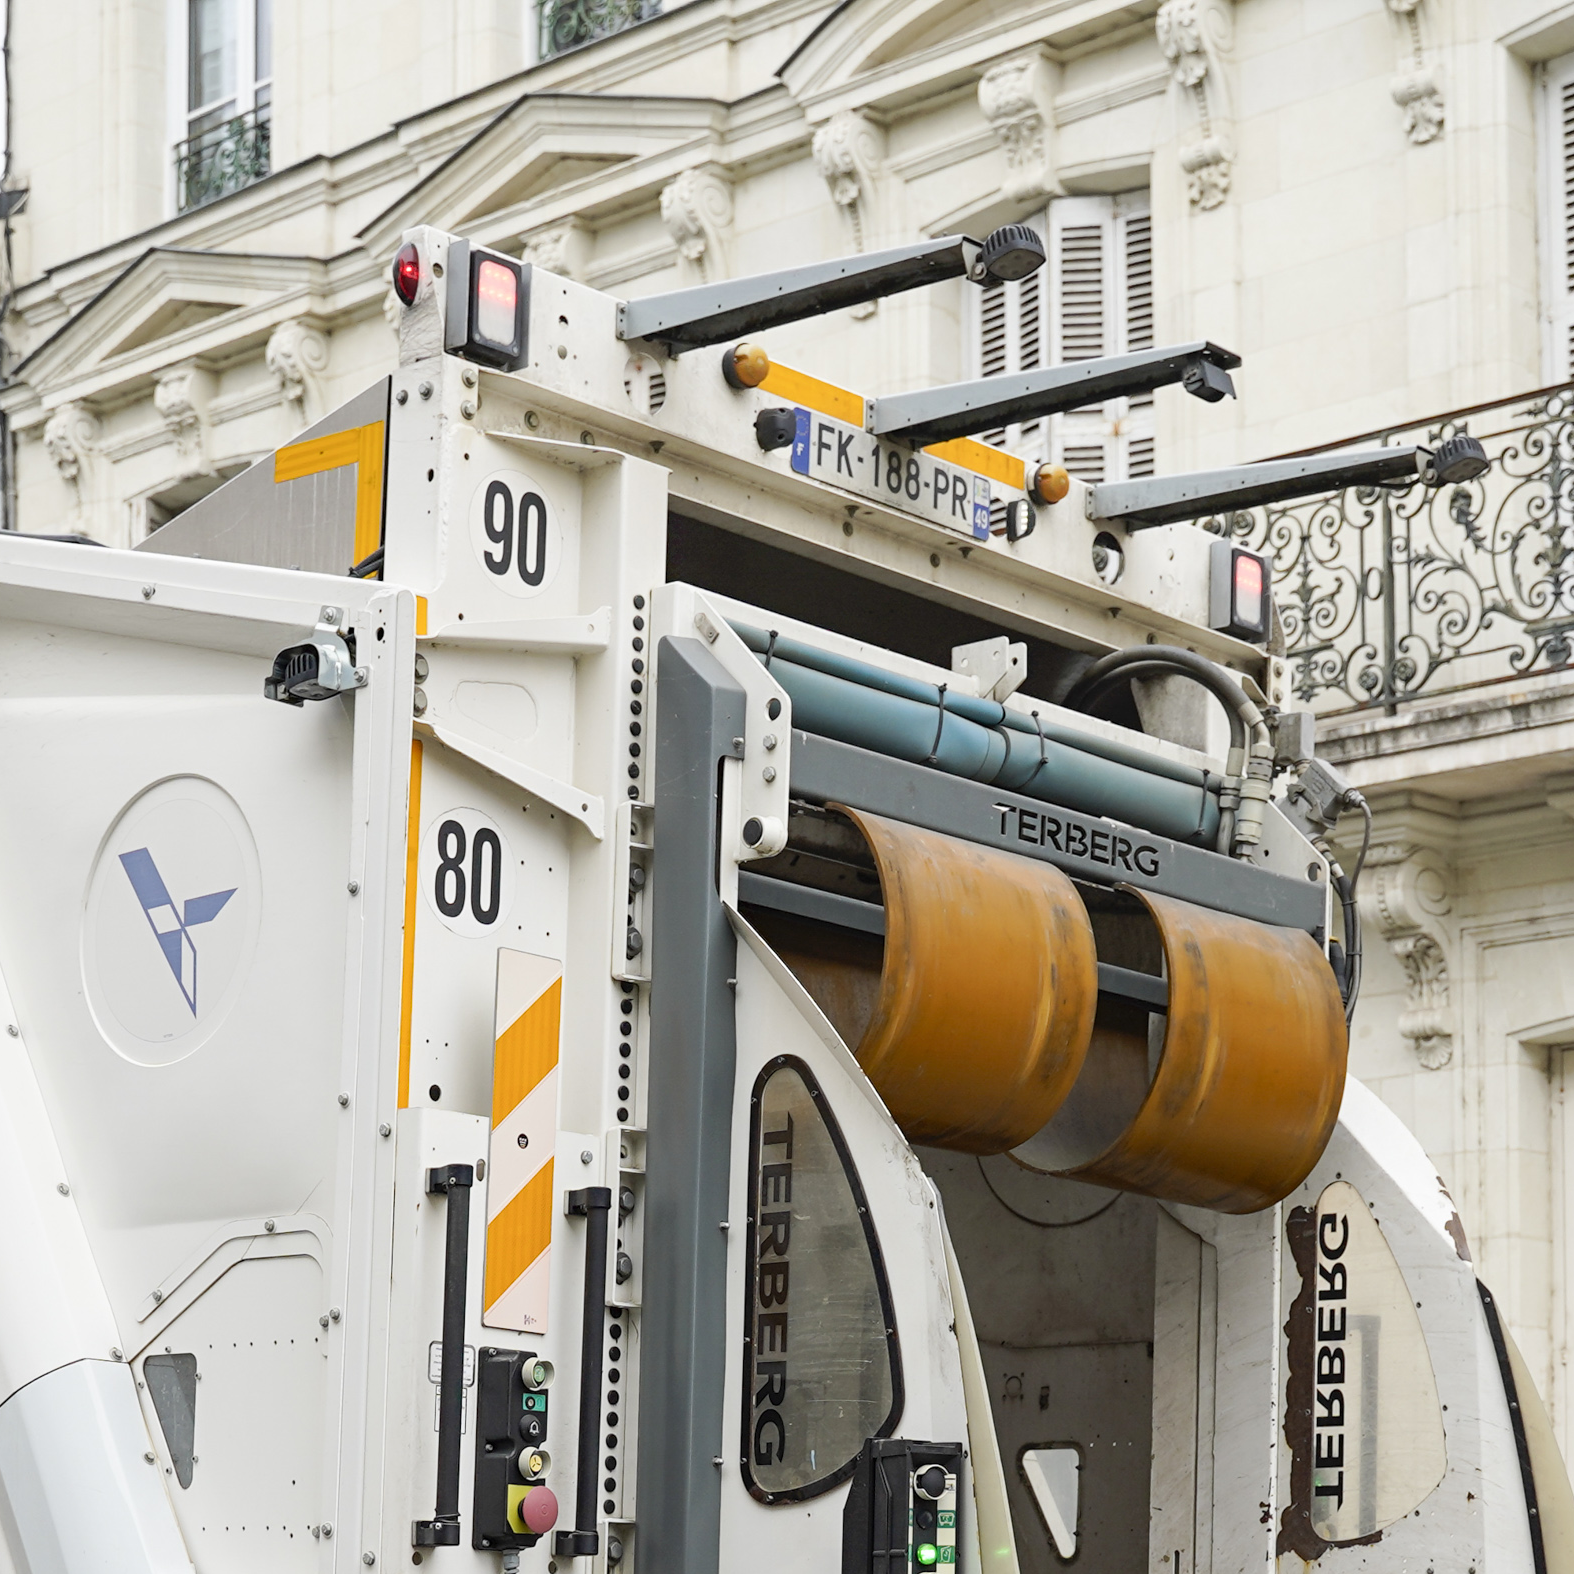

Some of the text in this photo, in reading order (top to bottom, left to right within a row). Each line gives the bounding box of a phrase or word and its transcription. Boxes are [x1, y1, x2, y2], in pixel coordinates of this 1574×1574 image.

[816, 422, 968, 521] FK-188-PR
[974, 508, 989, 530] 49
[482, 478, 547, 587] 90
[434, 818, 503, 927] 80
[991, 801, 1160, 878] TERBERG
[754, 1110, 793, 1466] TERBERG
